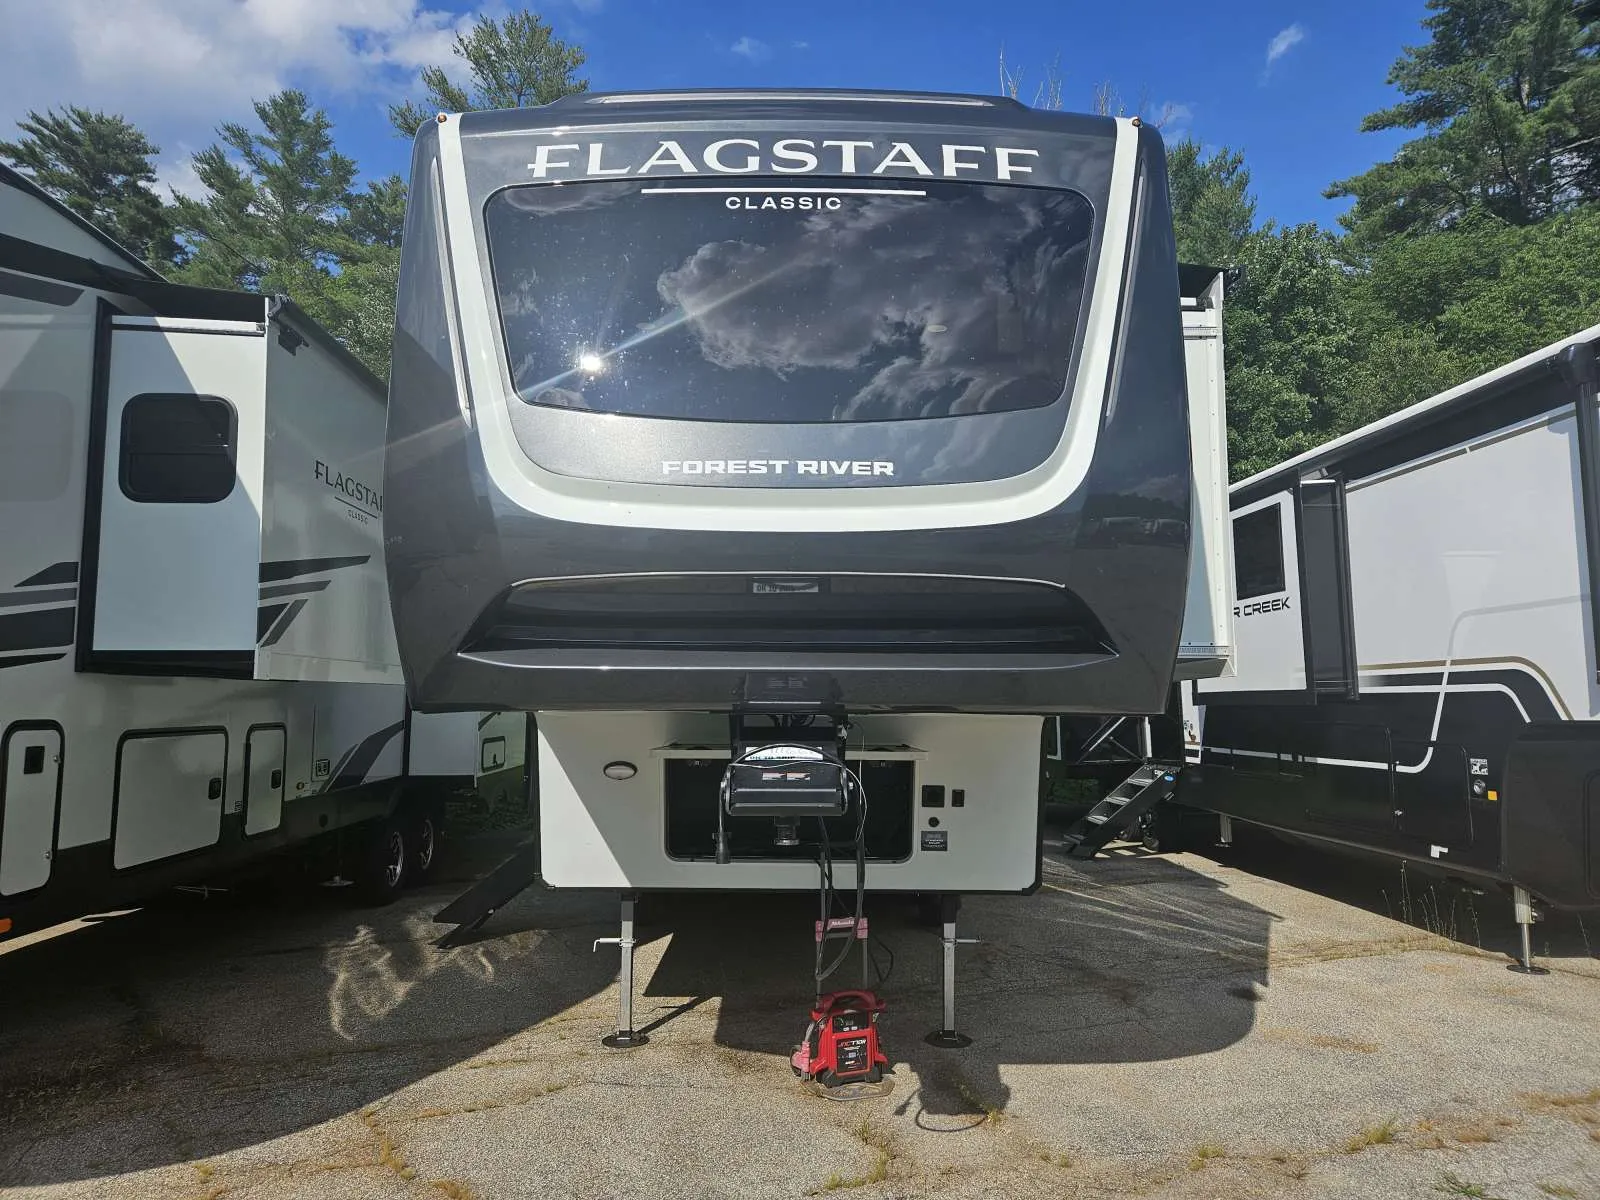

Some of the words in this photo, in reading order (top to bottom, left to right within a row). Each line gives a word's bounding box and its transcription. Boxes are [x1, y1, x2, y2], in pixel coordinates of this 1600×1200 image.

[527, 139, 1040, 180] FLAGSTAFF
[725, 196, 842, 210] CLASSIC
[662, 460, 790, 475] FOREST
[797, 461, 894, 476] RIVER
[314, 460, 383, 512] FLAGSTA
[1243, 597, 1291, 616] CREEK
